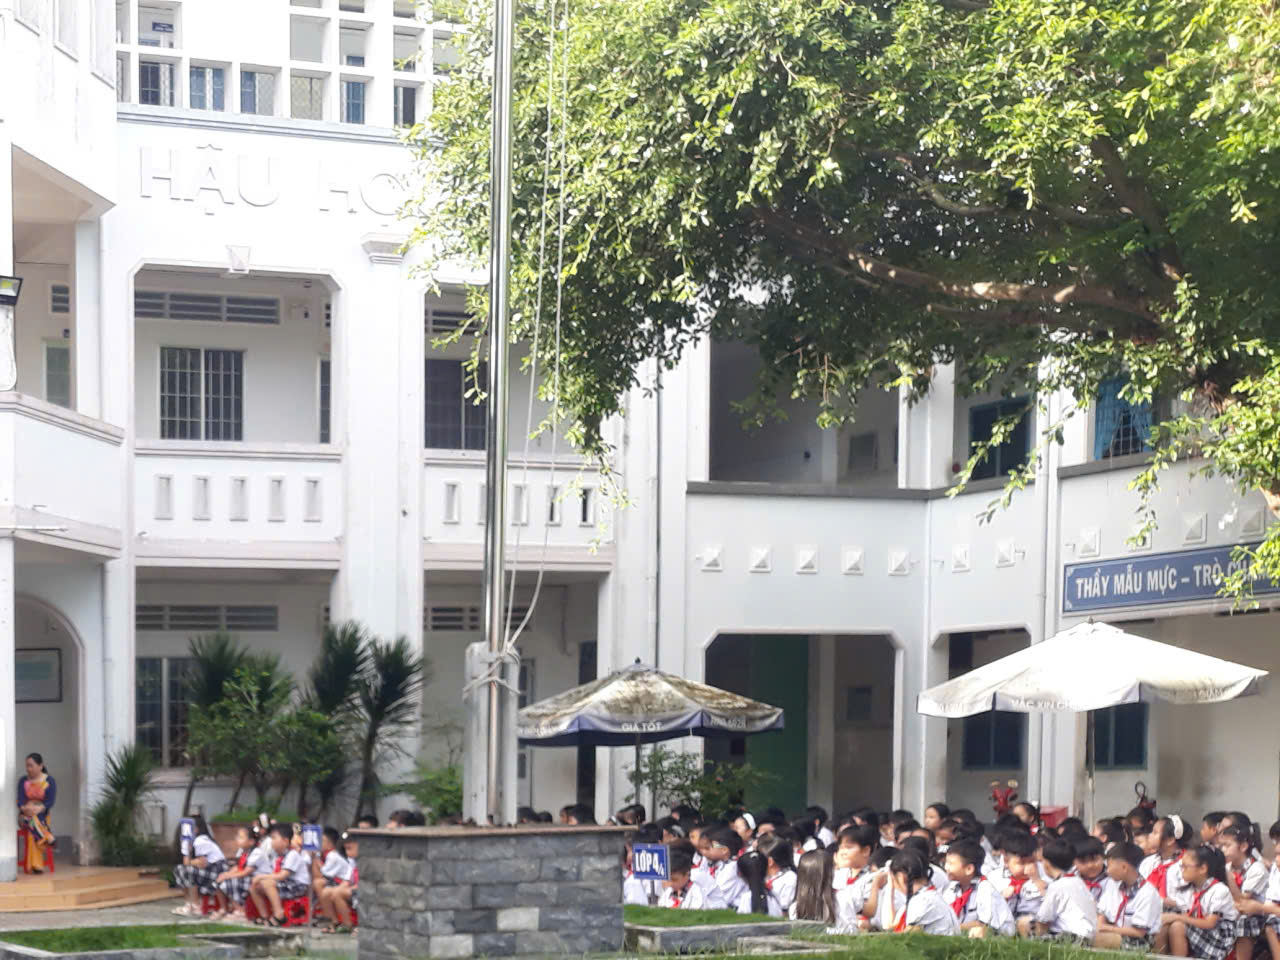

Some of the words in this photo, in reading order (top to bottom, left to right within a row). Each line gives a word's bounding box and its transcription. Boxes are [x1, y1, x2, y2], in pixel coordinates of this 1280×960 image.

[138, 143, 280, 217] HẬU
[1075, 567, 1108, 600] THẦY
[1113, 563, 1142, 596] MẪU
[1147, 565, 1177, 596] MỰC
[1193, 556, 1222, 588] TRÒ
